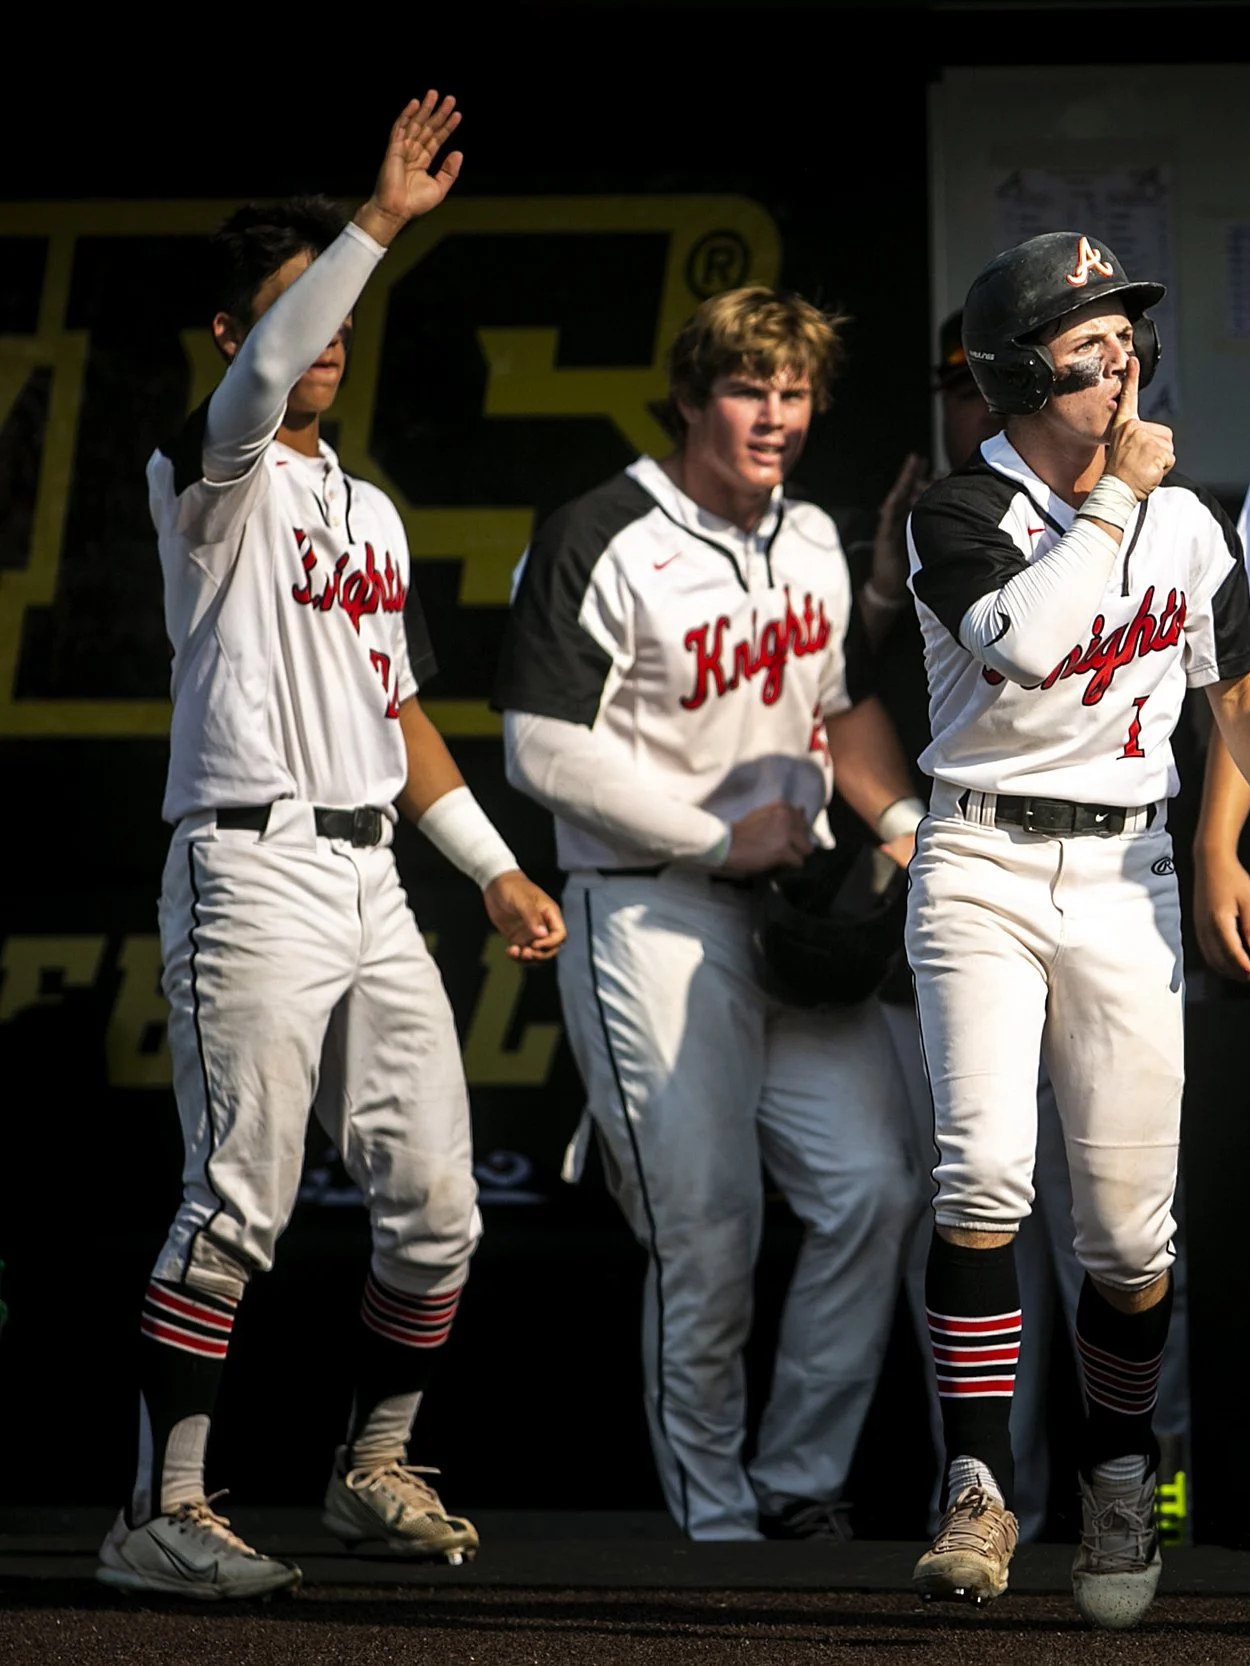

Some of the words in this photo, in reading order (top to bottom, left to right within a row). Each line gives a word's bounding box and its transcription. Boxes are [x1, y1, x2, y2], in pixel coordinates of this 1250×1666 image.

[293, 527, 407, 636] ight
[982, 585, 1186, 706] nights
[1116, 696, 1150, 760] 1
